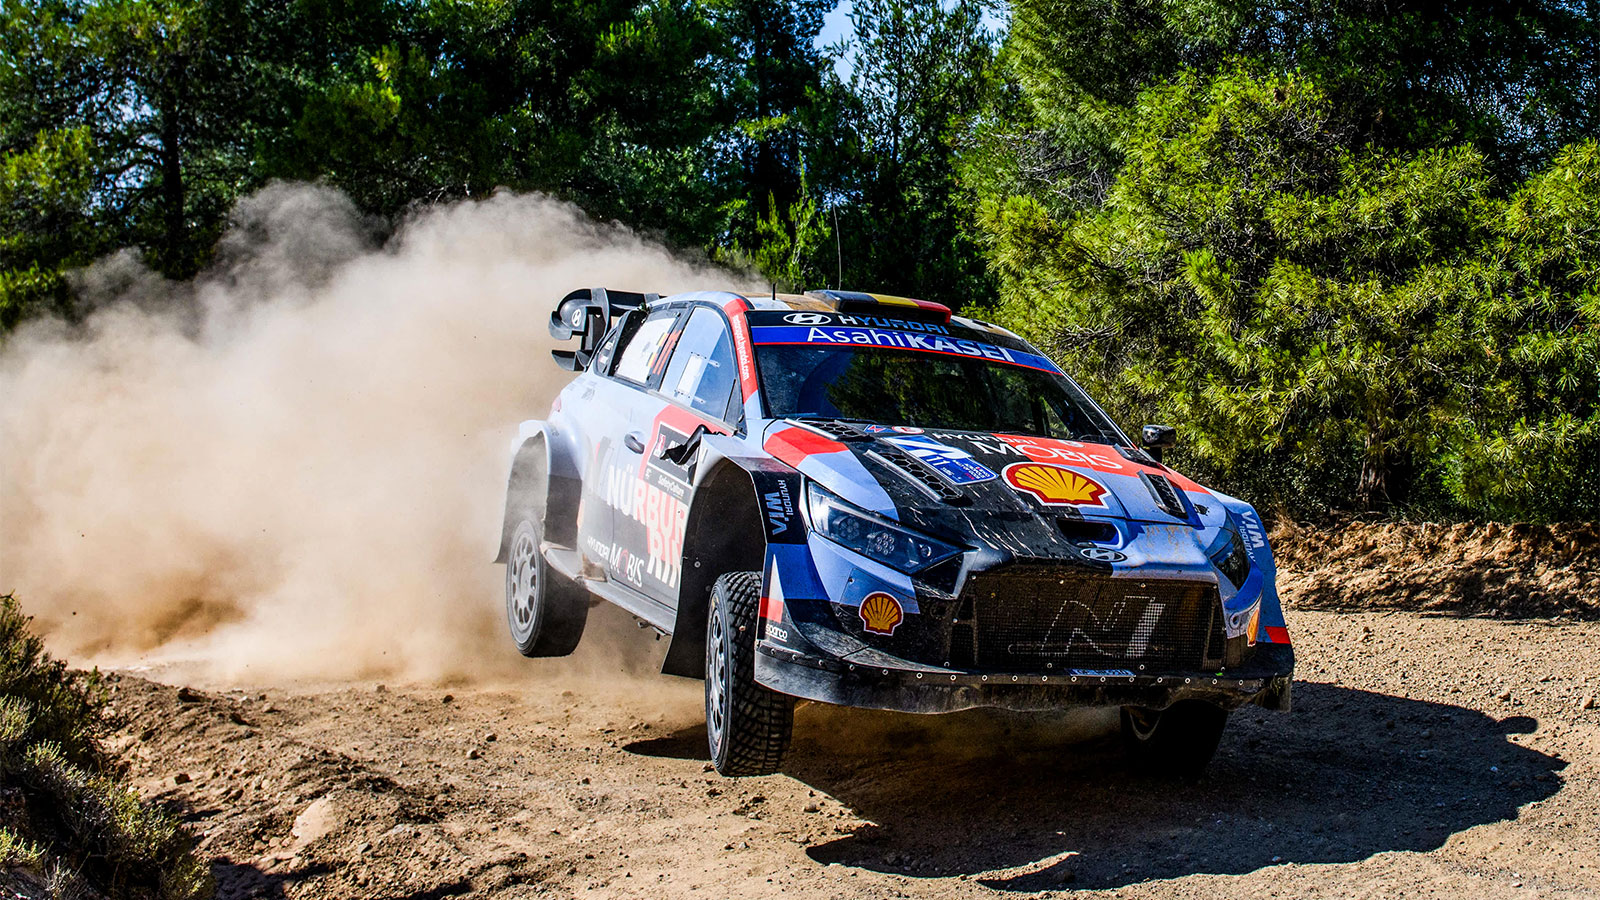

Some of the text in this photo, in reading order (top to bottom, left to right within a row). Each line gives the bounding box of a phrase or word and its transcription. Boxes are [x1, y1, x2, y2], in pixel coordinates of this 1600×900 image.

[838, 314, 950, 335] HYUNDAI
[933, 432, 1038, 446] HYUNDAI
[969, 441, 1123, 469] MOBIS
[777, 479, 794, 516] HYUNDAI
[764, 492, 787, 536] WIA
[587, 535, 645, 588] HYUNDAI MOBIS
[765, 624, 788, 639] sparco
